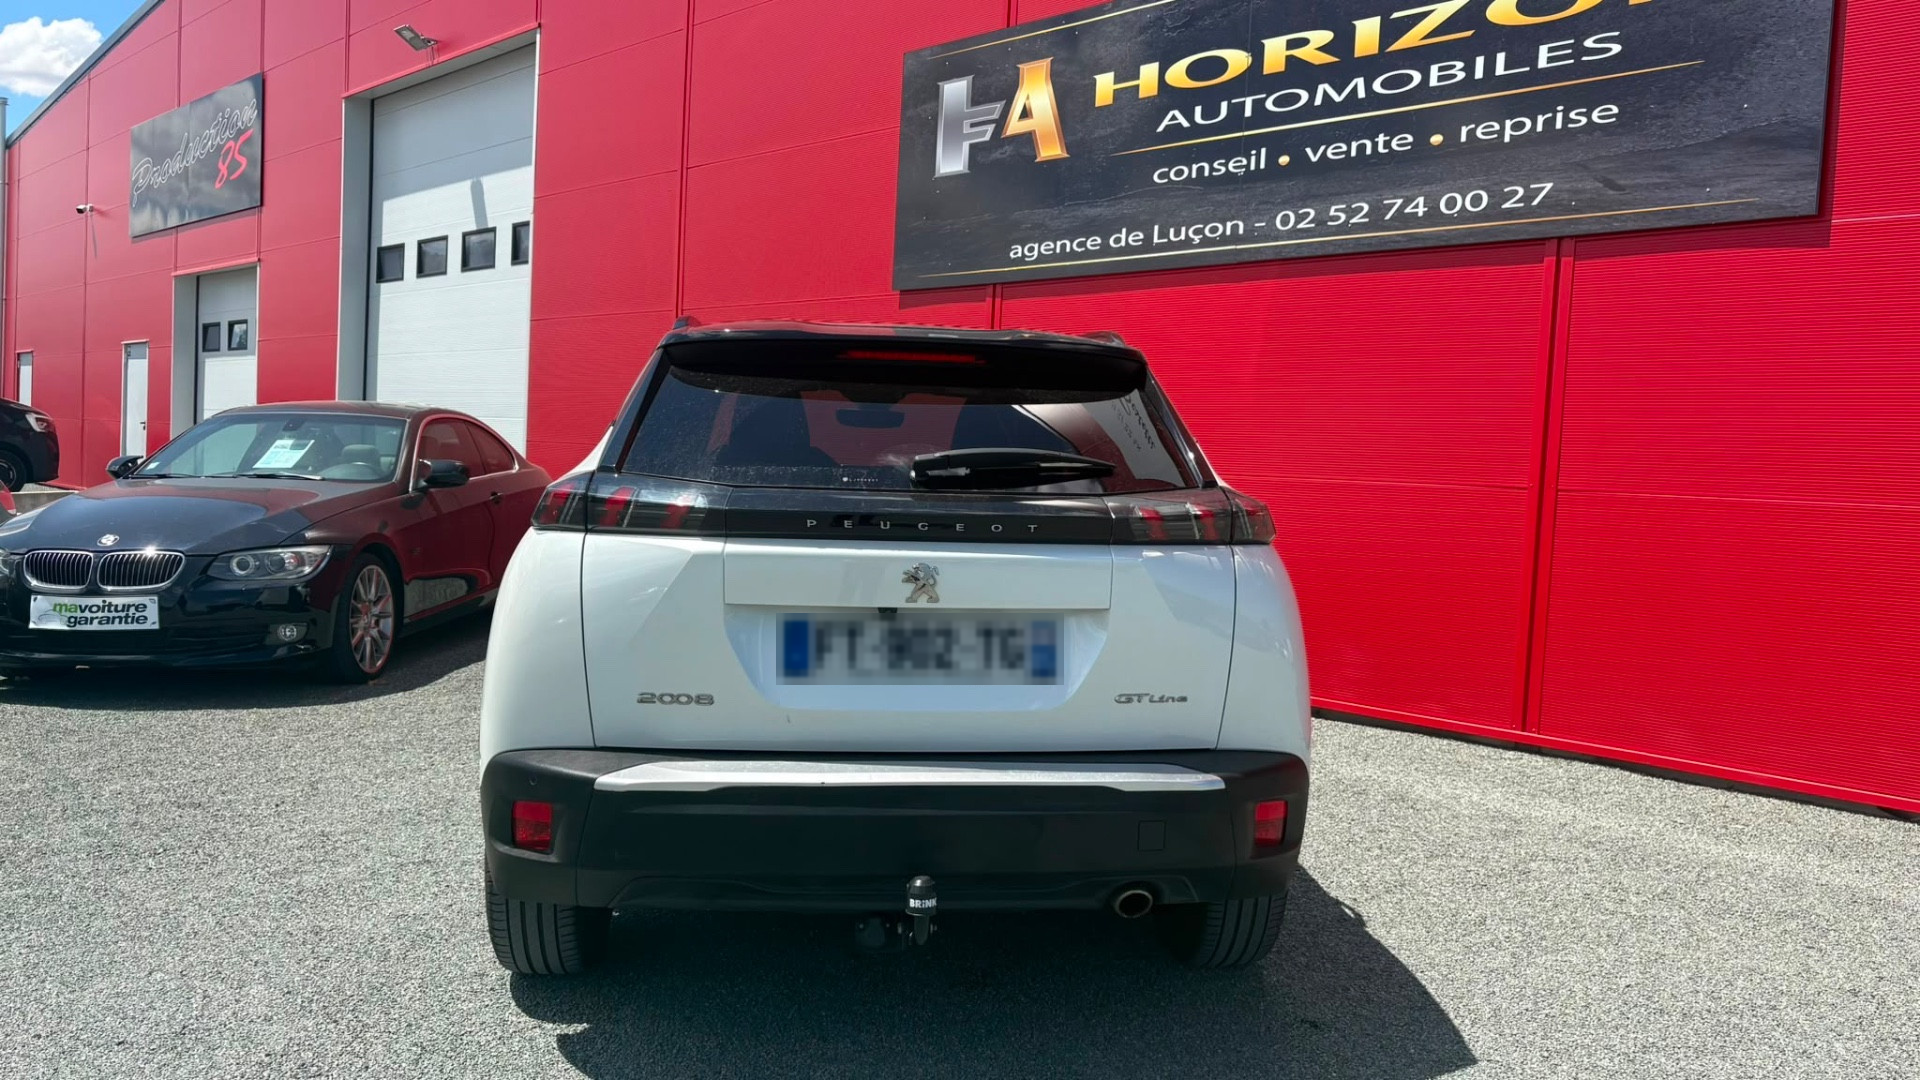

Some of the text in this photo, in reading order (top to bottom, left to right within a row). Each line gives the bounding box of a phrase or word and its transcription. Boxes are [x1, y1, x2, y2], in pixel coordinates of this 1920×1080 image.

[1093, 0, 1651, 107] HORIZO
[1156, 31, 1622, 133] AUTOMOBILES
[132, 99, 258, 207] Production
[214, 128, 254, 189] 85
[1153, 103, 1620, 184] conseil vente reprise
[1009, 236, 1102, 261] agence
[1109, 227, 1144, 248] de
[1152, 219, 1245, 245] Luçon
[1274, 207, 1316, 231] 02
[1327, 202, 1370, 226] 52
[1382, 196, 1428, 221] 74
[1439, 190, 1489, 215] 00
[1501, 182, 1555, 209] 27
[805, 518, 1039, 534] PEUGEOT
[52, 600, 148, 614] mavoiture
[66, 612, 148, 628] garantie
[636, 691, 716, 706] 2008
[1114, 692, 1151, 704] GT
